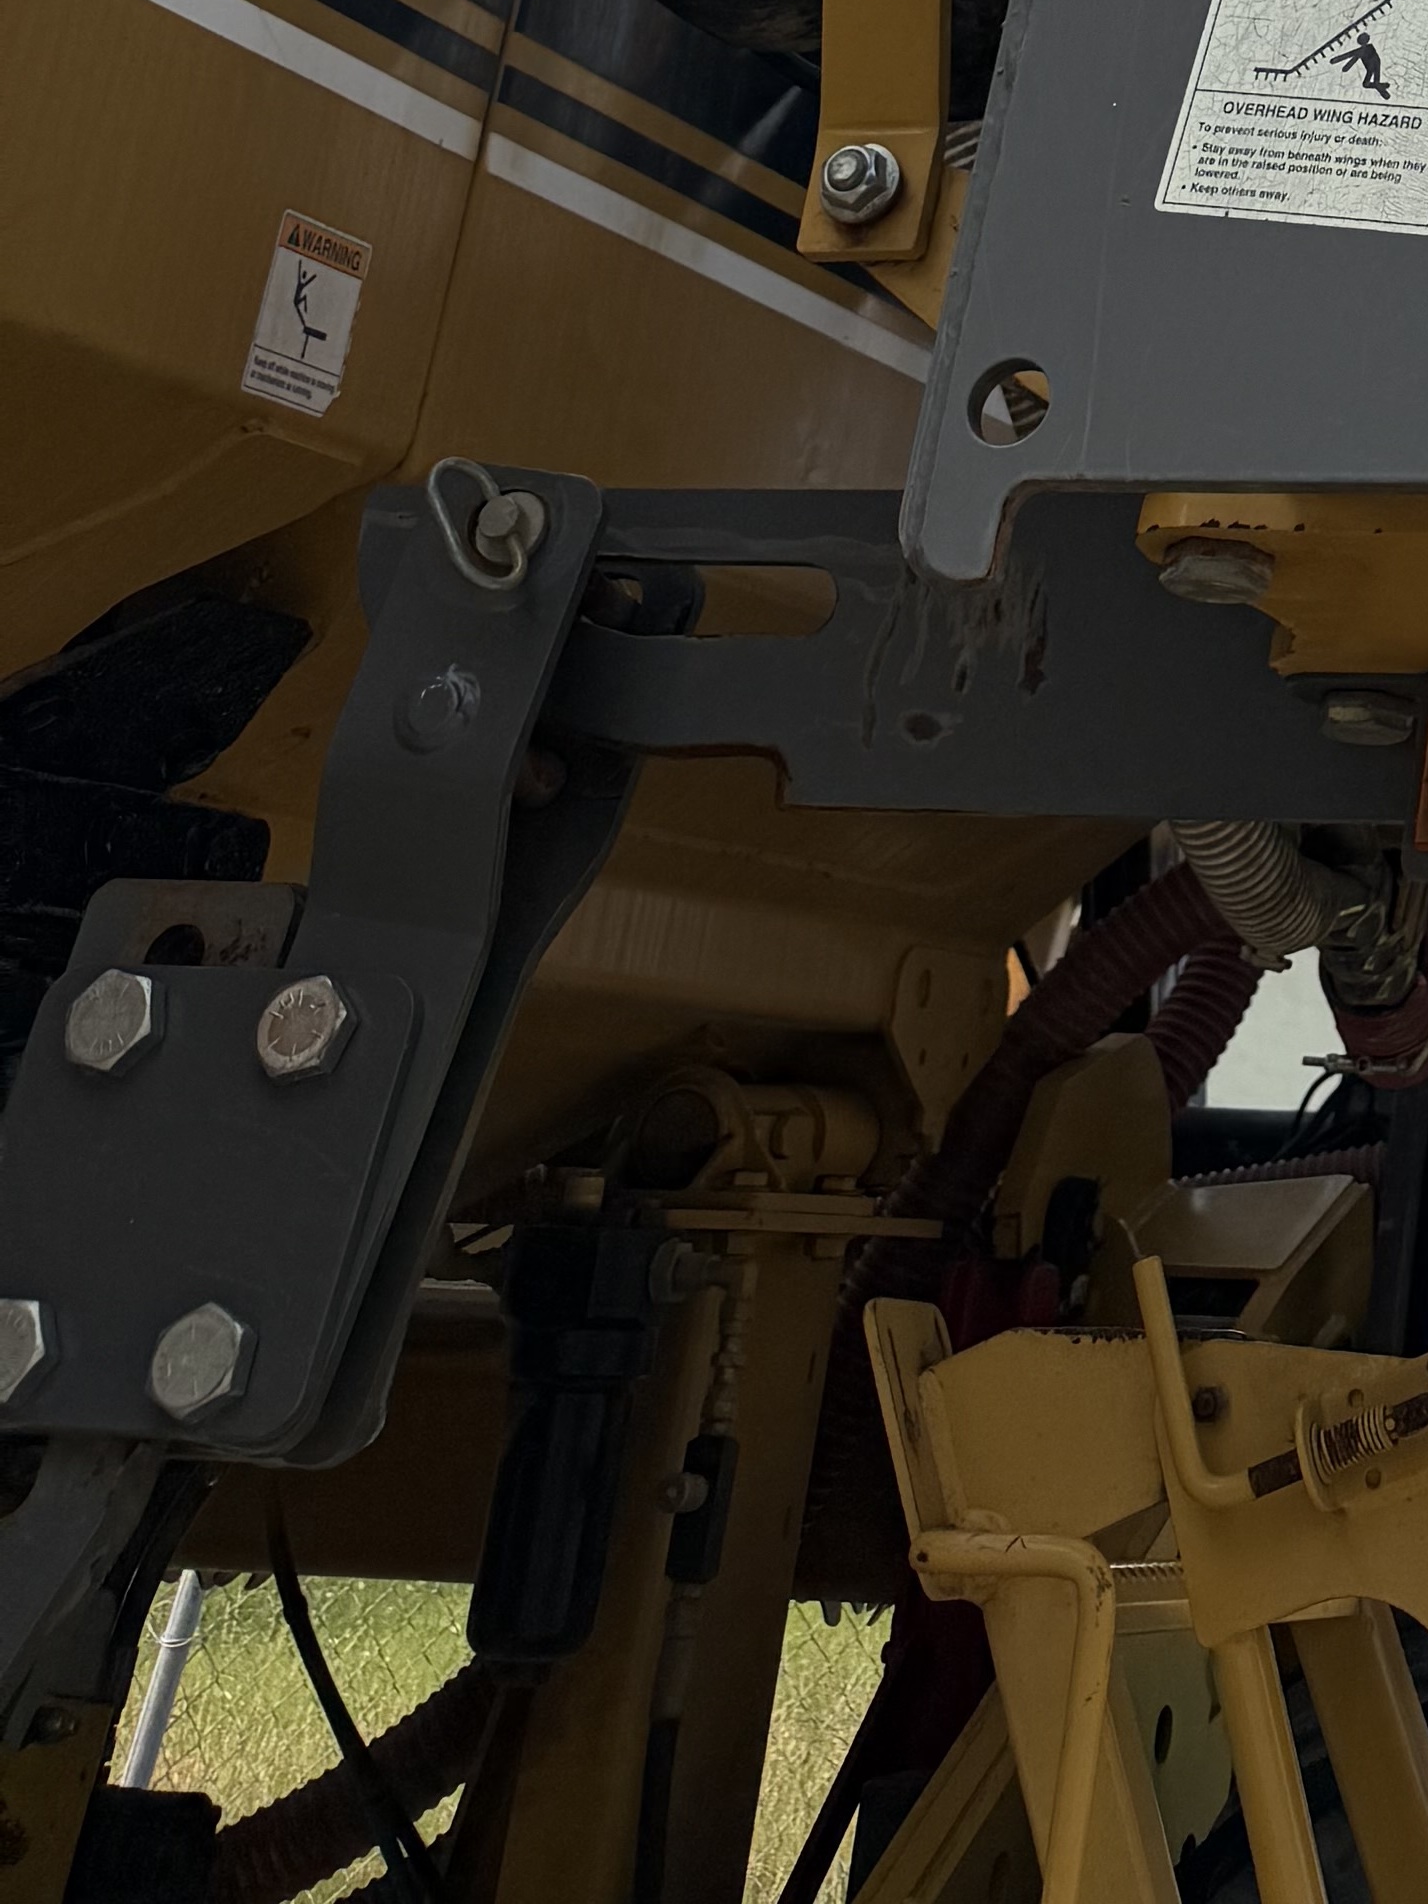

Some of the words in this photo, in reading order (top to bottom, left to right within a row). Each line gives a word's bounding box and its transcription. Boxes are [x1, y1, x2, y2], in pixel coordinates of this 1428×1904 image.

[1223, 101, 1308, 120] OVERHEAD
[1313, 108, 1353, 124] WING
[1357, 111, 1422, 130] HAZARD
[1199, 122, 1212, 132] To
[1213, 125, 1256, 137] prevent
[1257, 128, 1298, 140] serious
[1300, 131, 1332, 144] injury
[1334, 135, 1346, 143] or
[1197, 156, 1216, 166] are
[1218, 156, 1229, 167] in
[1231, 158, 1250, 169] the
[1252, 160, 1286, 171] raised
[1287, 163, 1333, 176] position
[1350, 168, 1368, 179] are
[1370, 169, 1402, 184] being
[1201, 142, 1226, 156] Stay
[1228, 146, 1257, 159] away
[1259, 147, 1286, 160] from
[1287, 149, 1332, 163] beneath
[1335, 155, 1368, 168] wings
[1370, 157, 1400, 169] when
[1402, 160, 1427, 174] they
[1190, 183, 1219, 196] Keep
[1221, 186, 1257, 198] others
[1258, 189, 1290, 203] away.
[301, 230, 363, 272] WARNING
